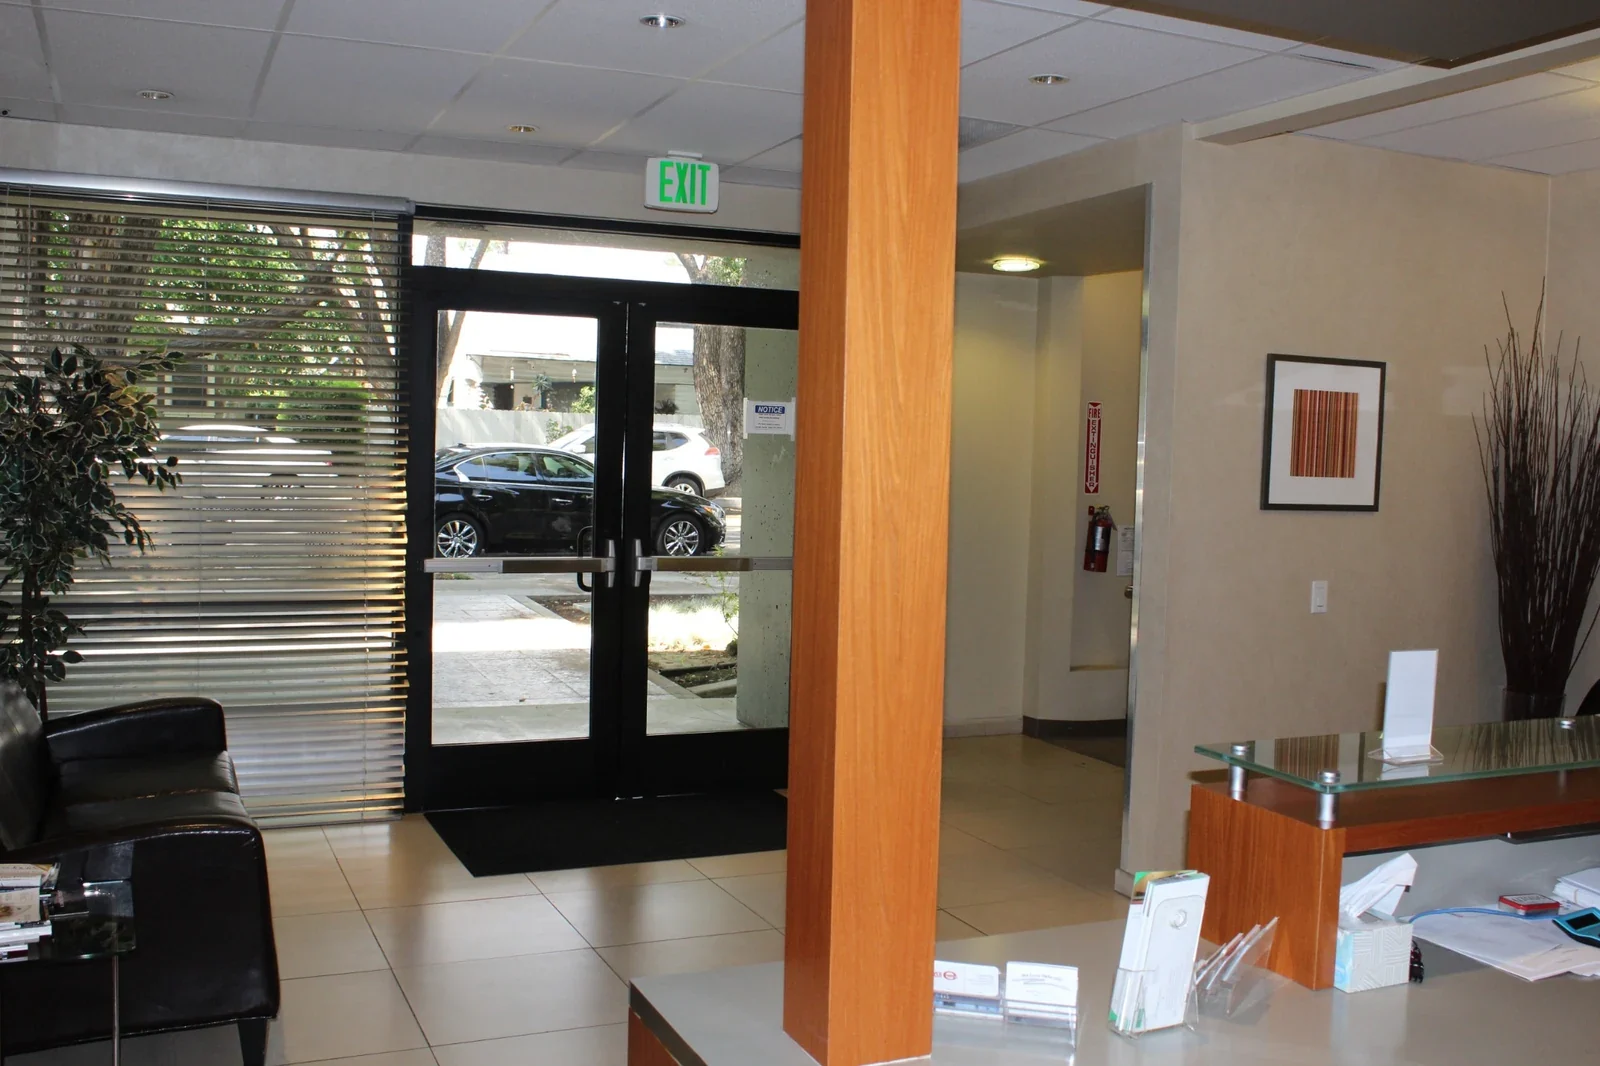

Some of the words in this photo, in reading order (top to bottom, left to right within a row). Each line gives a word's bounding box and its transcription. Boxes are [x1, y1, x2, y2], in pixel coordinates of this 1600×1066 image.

[659, 160, 711, 206] EXIT
[1088, 408, 1101, 418] FIRE
[1089, 420, 1097, 487] EXTINGUISHER
